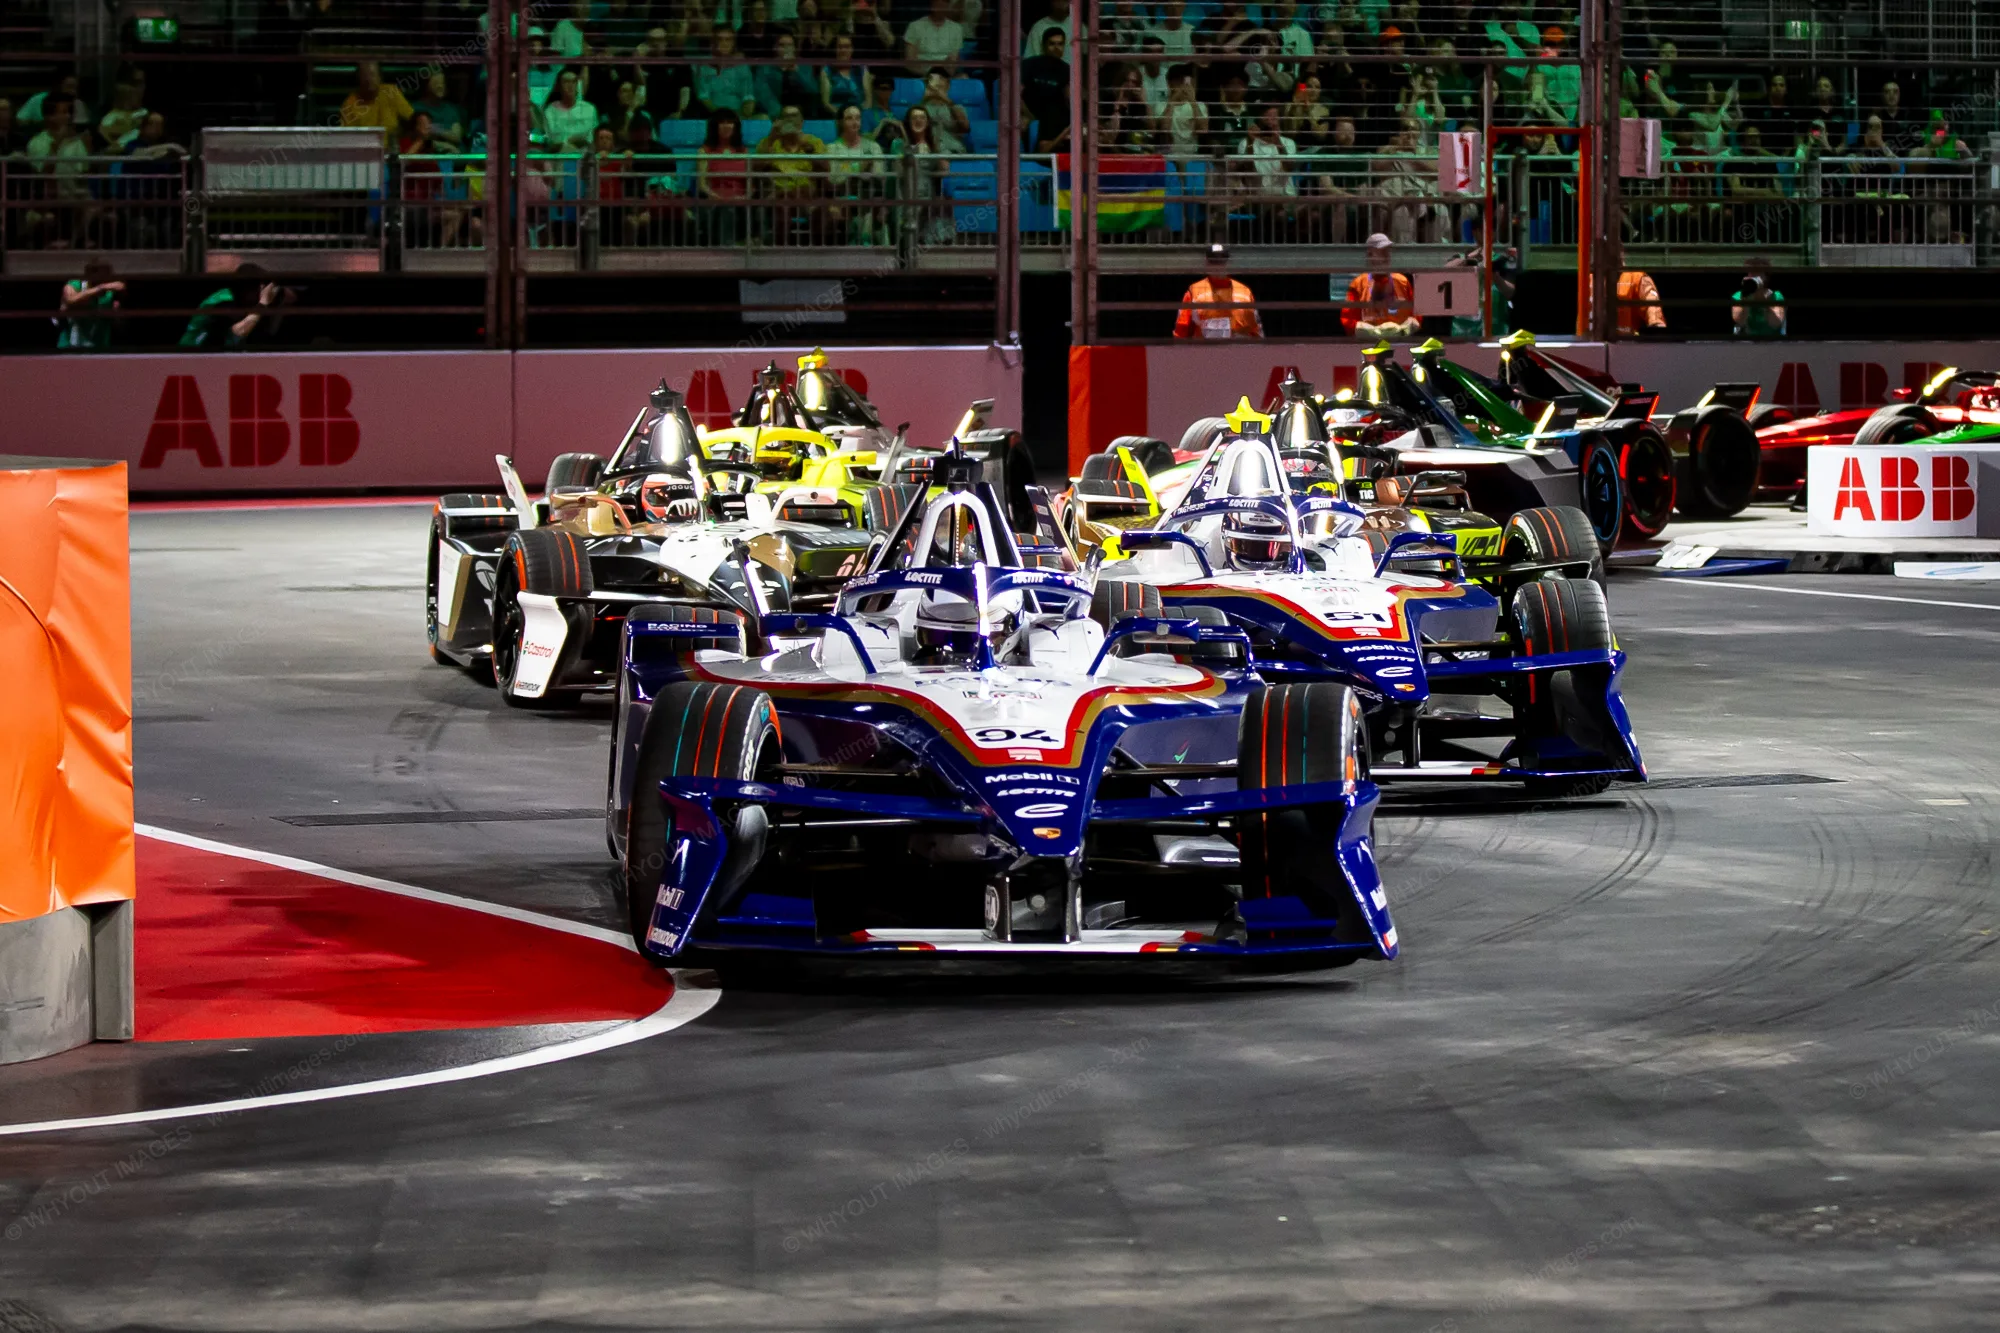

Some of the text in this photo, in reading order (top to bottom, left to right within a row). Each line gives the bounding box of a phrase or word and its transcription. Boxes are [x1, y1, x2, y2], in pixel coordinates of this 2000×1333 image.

[1438, 281, 1453, 310] 1
[138, 374, 361, 468] ABB
[1833, 456, 1976, 521] ABB
[1228, 499, 1260, 508] LOCTITE
[905, 571, 943, 584] LOCTITE
[1324, 611, 1386, 623] 51
[1343, 644, 1395, 654] Mobil
[975, 729, 1060, 742] 94
[985, 772, 1053, 784] Mobil
[997, 787, 1077, 797] LOCTITE
